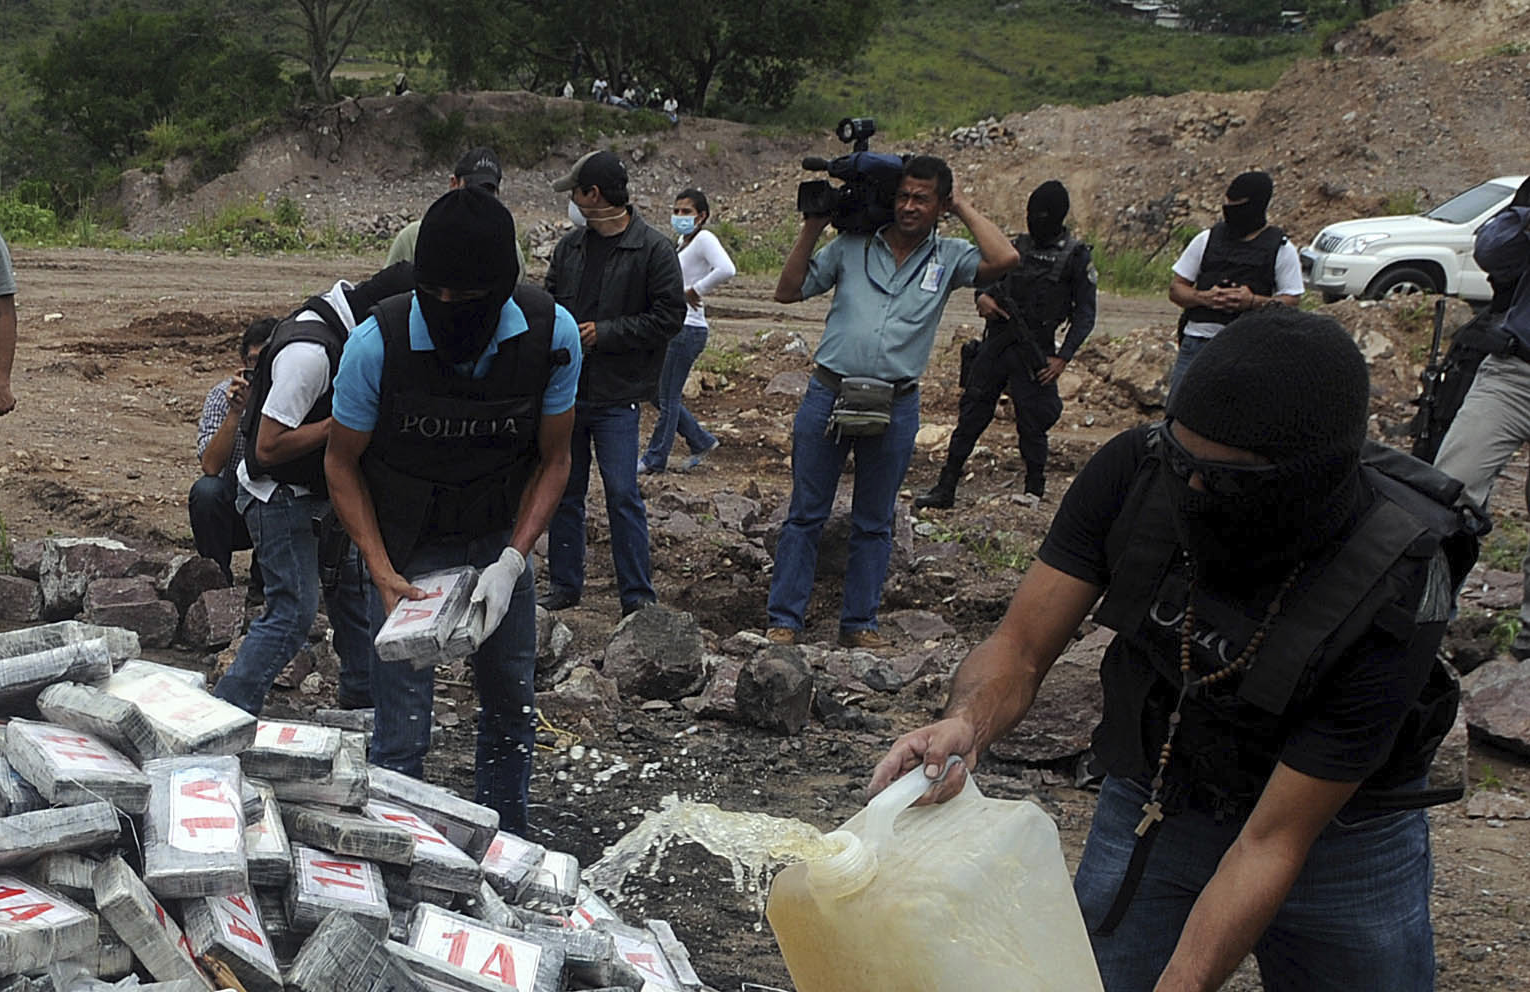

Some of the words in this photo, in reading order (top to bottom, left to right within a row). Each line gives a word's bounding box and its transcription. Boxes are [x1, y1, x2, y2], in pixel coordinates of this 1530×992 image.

[399, 414, 519, 438] POLICIA
[181, 780, 235, 837] 1A
[310, 860, 365, 891] 1A
[442, 929, 518, 988] 1A
